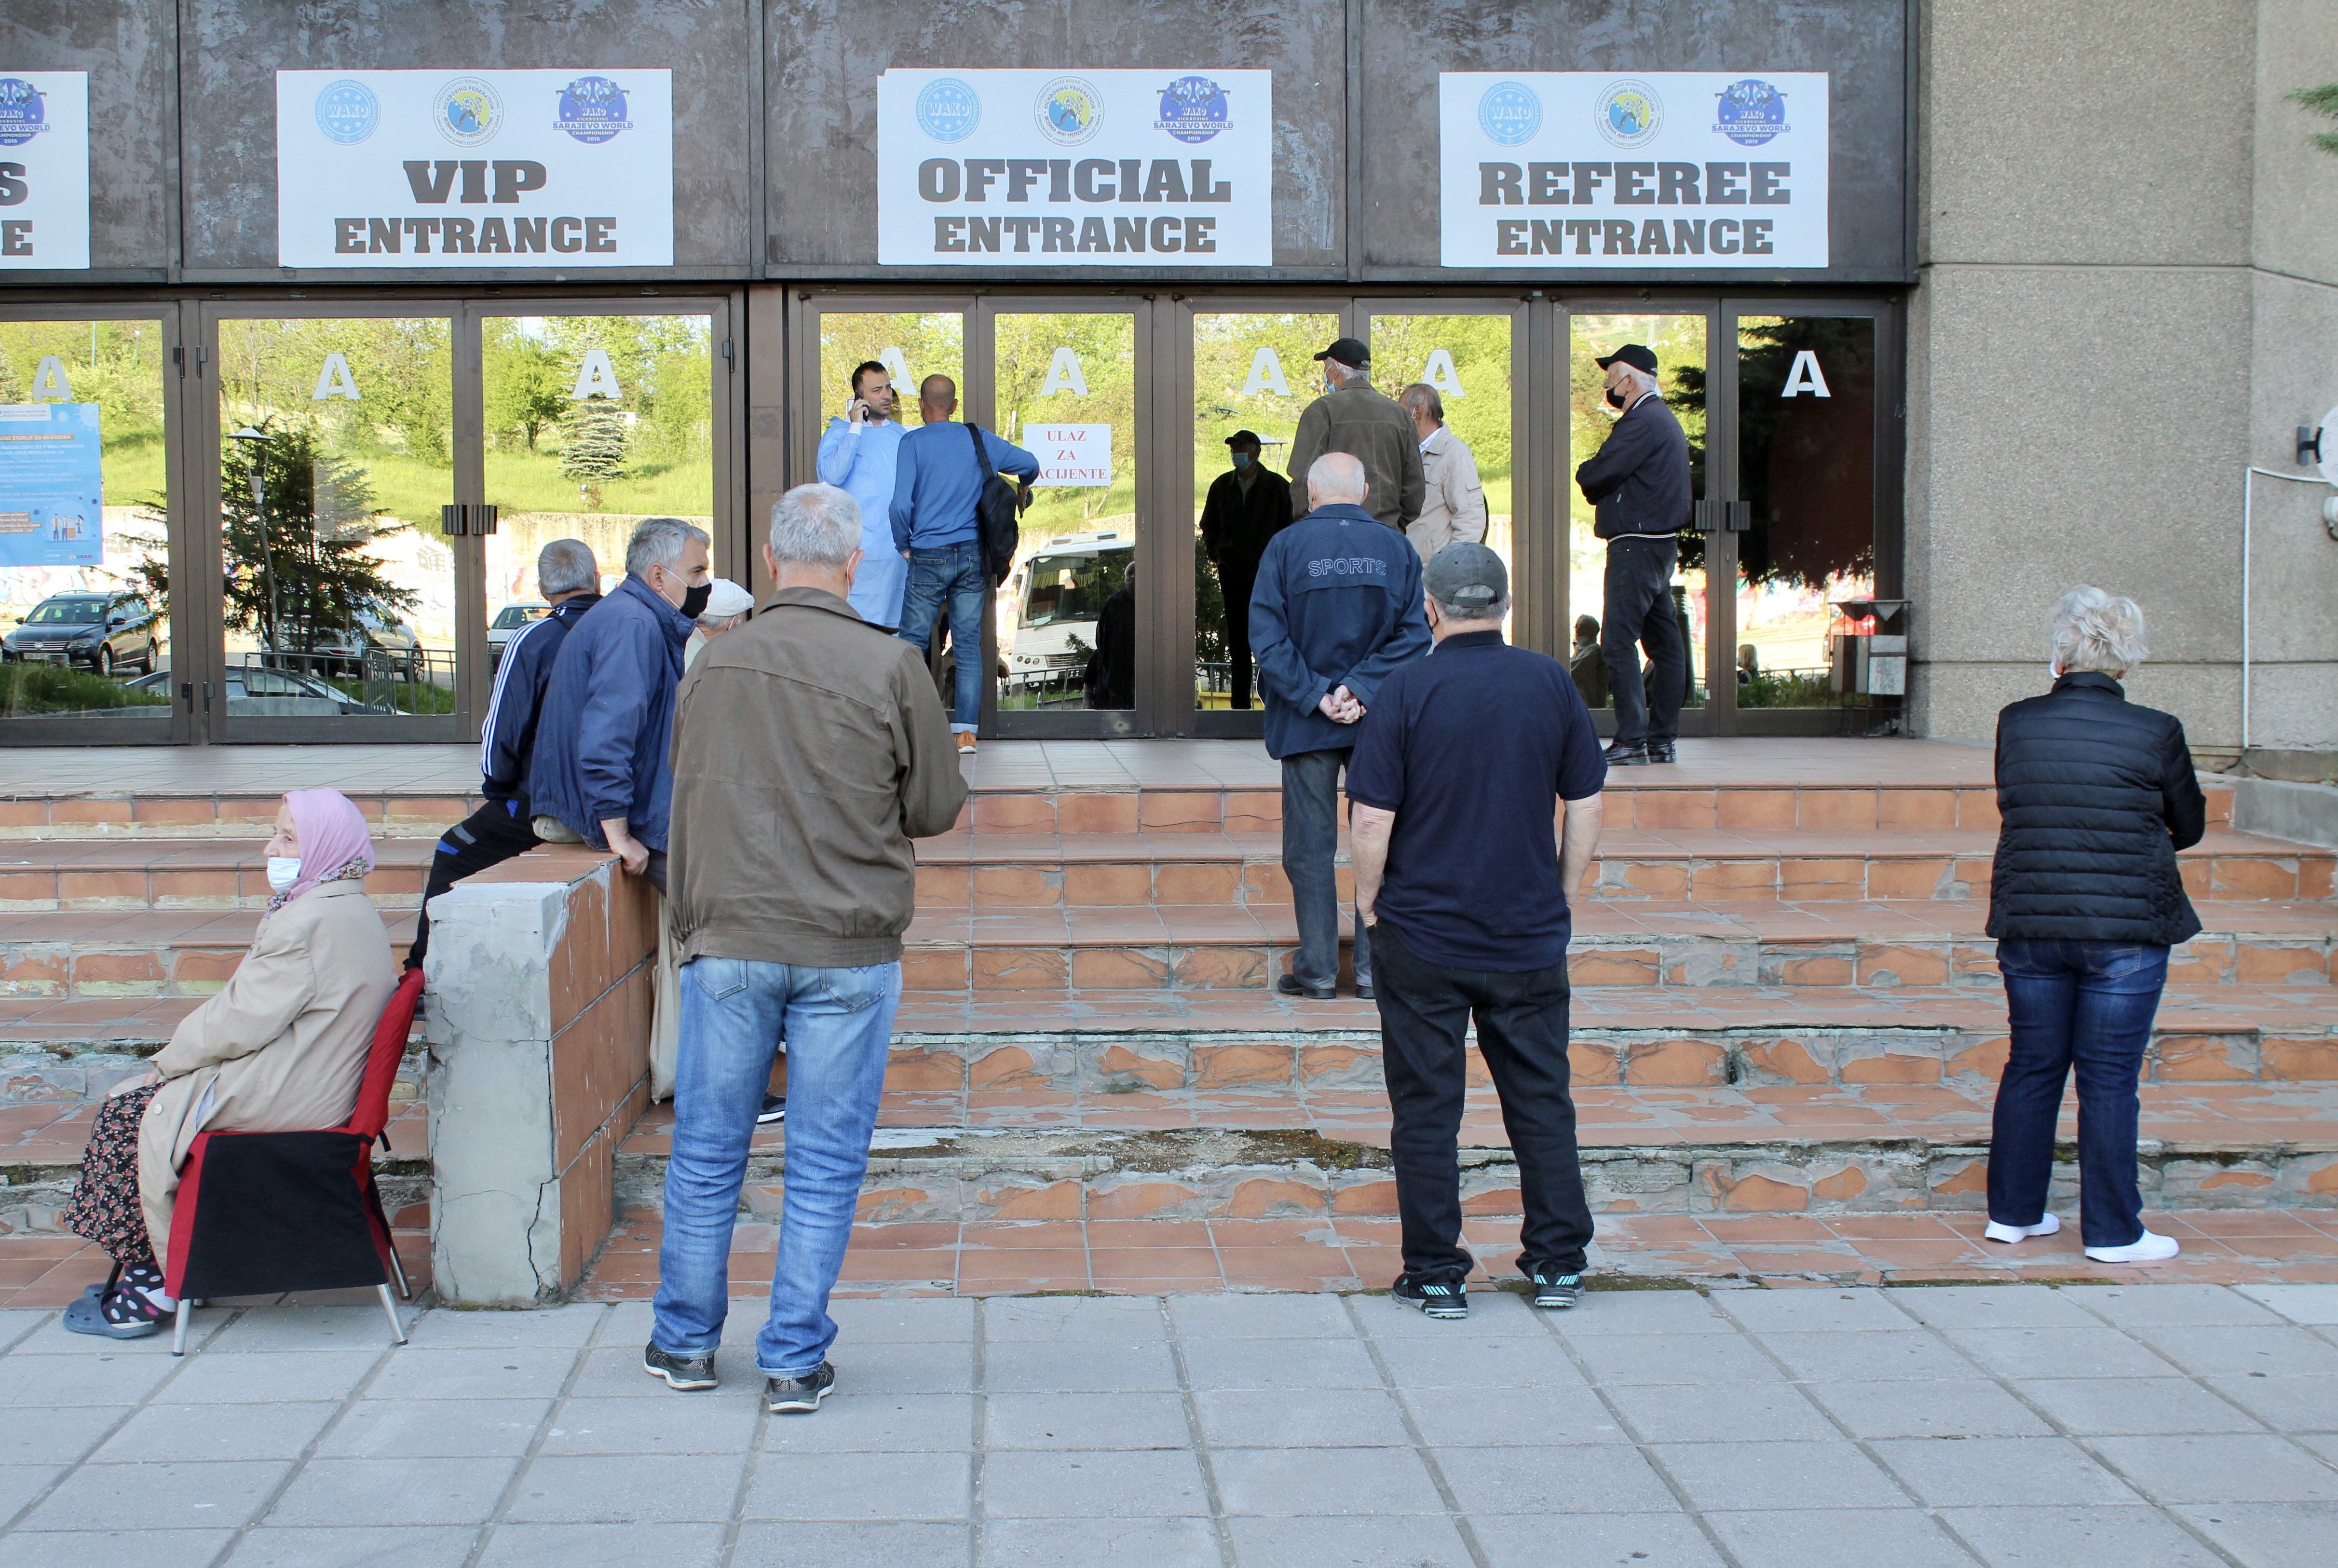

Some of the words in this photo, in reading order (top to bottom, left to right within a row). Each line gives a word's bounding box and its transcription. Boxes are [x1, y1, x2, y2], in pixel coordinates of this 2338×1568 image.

[443, 86, 467, 109] KICKBOXING
[469, 86, 494, 109] FEDERATION
[926, 102, 969, 116] WAKO
[1044, 85, 1068, 109] KICKBOXING
[1070, 85, 1095, 109] FEDERATION
[1604, 88, 1628, 112] KICKBOXING
[1630, 88, 1655, 111] FEDERATION
[327, 104, 369, 118] WAKO
[581, 108, 606, 116] WAKO
[1181, 107, 1207, 116] WAKO
[1489, 106, 1532, 120] WAKO
[1740, 110, 1765, 119] WAKO
[1044, 116, 1057, 133] BOSNIA
[402, 160, 547, 204] VIP
[918, 158, 1231, 202] OFFICIAL
[1479, 162, 1790, 205] REFEREE
[335, 217, 616, 253] ENTRANCE
[934, 216, 1216, 253] ENTRANCE
[1497, 219, 1773, 255] ENTRANCE
[32, 355, 72, 402] A
[312, 354, 361, 400] A
[572, 349, 623, 398] A
[1040, 347, 1088, 395] A
[1242, 347, 1292, 396] A
[1421, 349, 1466, 397] A
[1781, 350, 1831, 397] A
[1047, 431, 1087, 441] ULAZ
[1057, 450, 1076, 460] ZA
[1039, 468, 1107, 479] ACIJENTE
[1308, 558, 1386, 577] SPORTS
